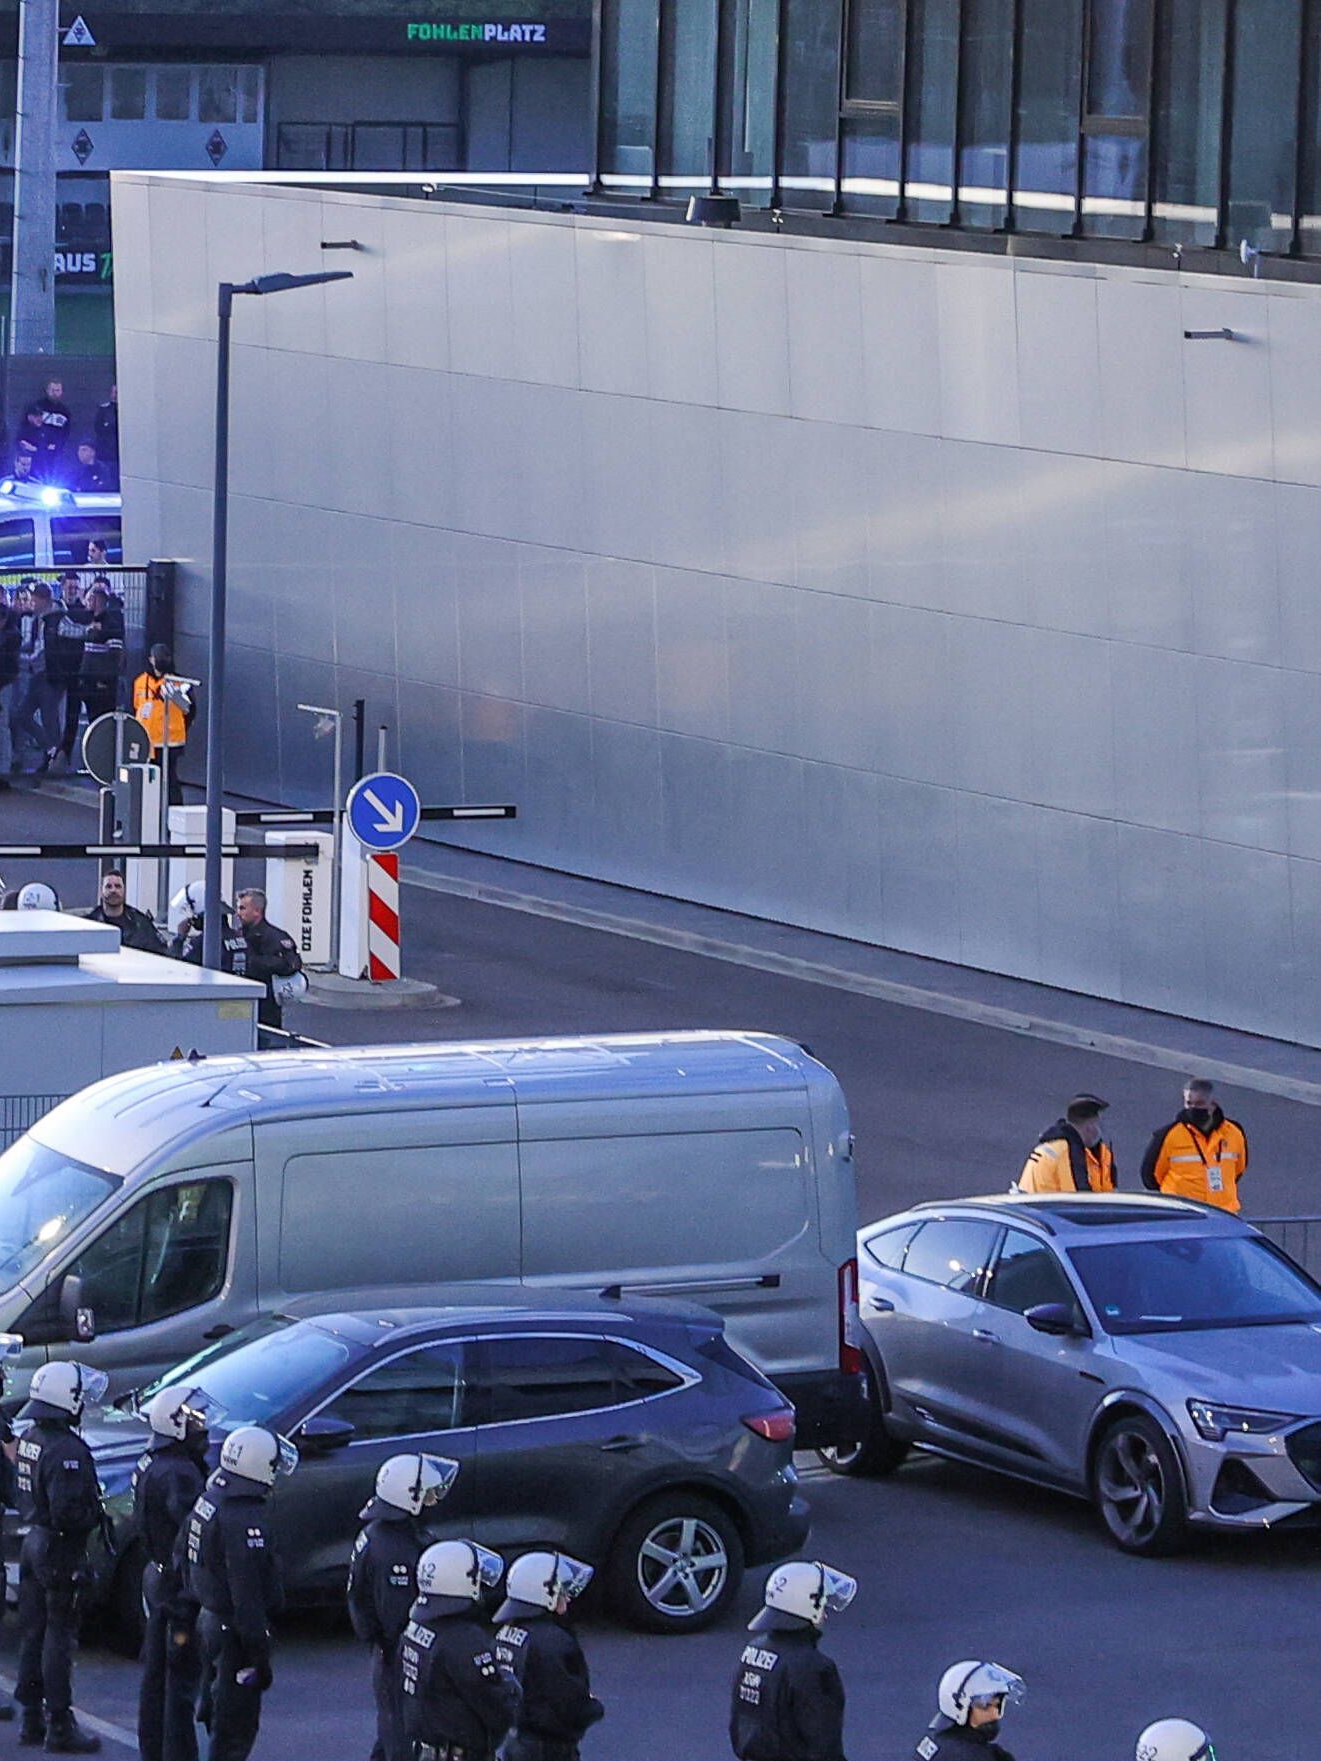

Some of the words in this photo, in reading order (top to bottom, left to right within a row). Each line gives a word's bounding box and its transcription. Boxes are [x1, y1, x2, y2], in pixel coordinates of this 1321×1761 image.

[407, 23, 546, 42] FOHLENPLATZ
[301, 869, 314, 924] FOHLEN
[301, 925, 312, 951] DIE
